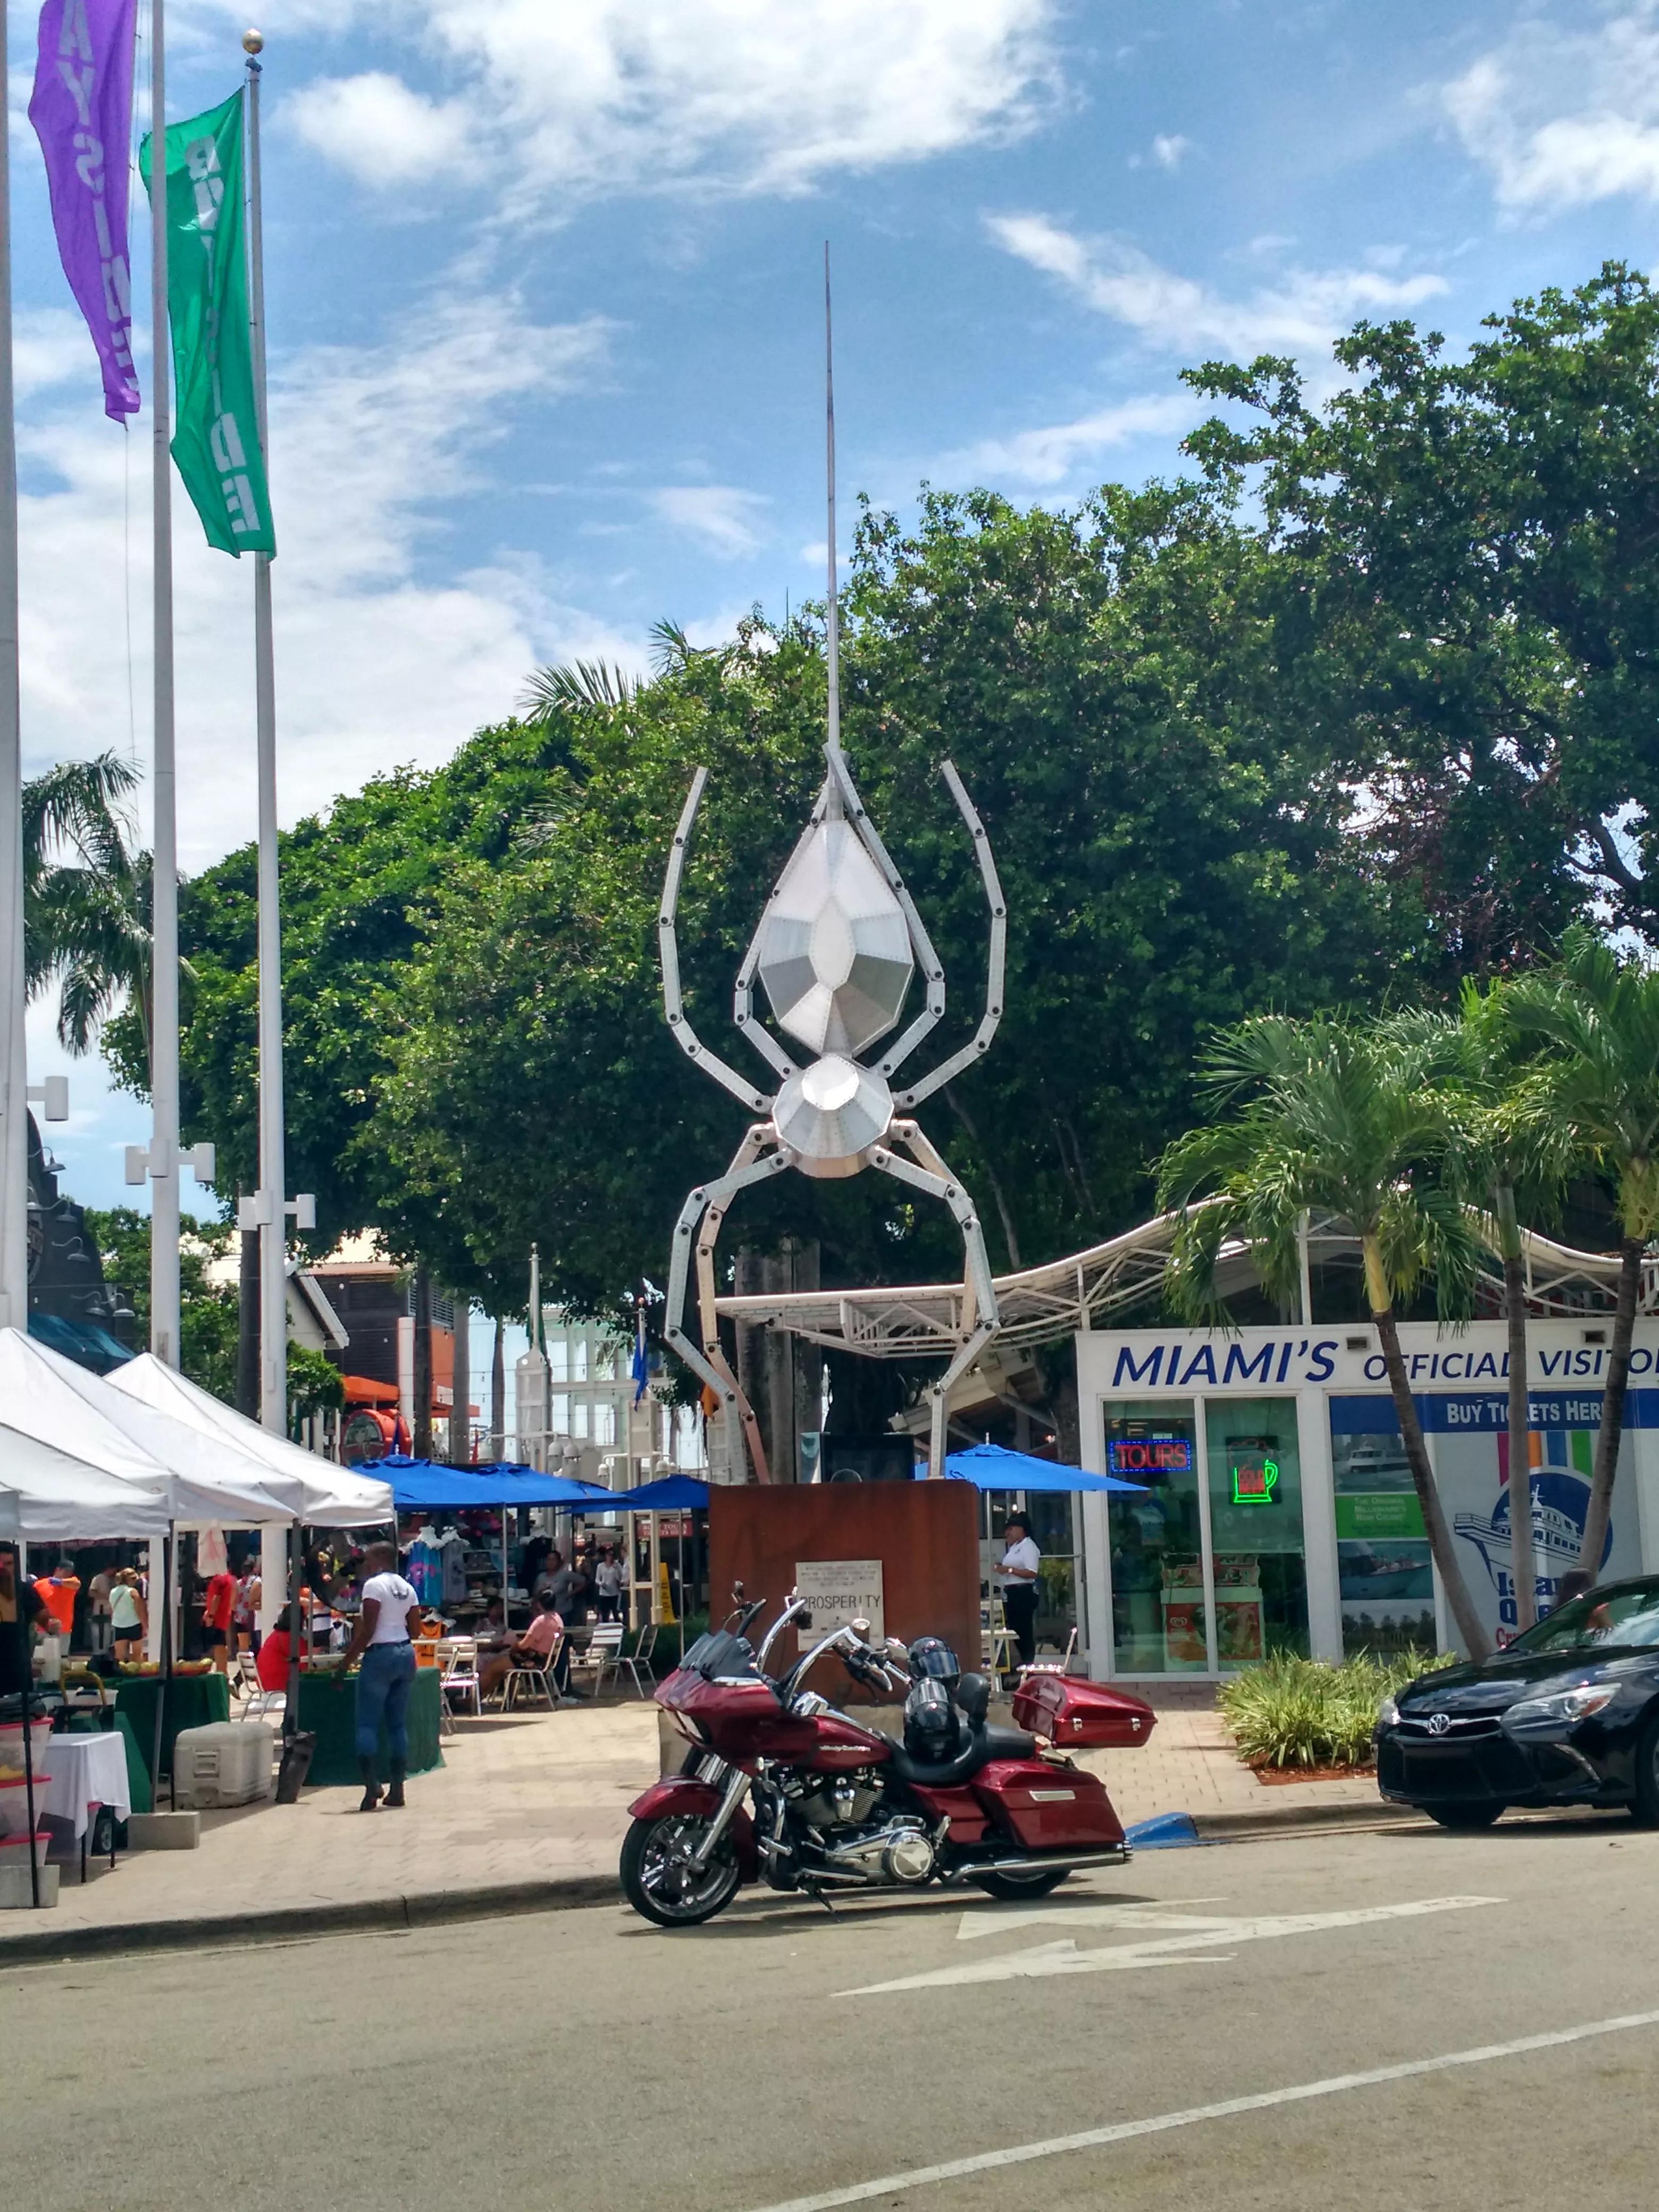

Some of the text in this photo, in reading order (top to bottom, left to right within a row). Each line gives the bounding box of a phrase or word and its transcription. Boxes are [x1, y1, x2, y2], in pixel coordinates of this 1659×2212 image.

[1112, 1339, 1339, 1387] MIAMI'S
[1364, 1348, 1659, 1380] OFICIAL VISIO
[1447, 1400, 1604, 1423] BUY TIETS HER
[1115, 1444, 1187, 1468] TOURS
